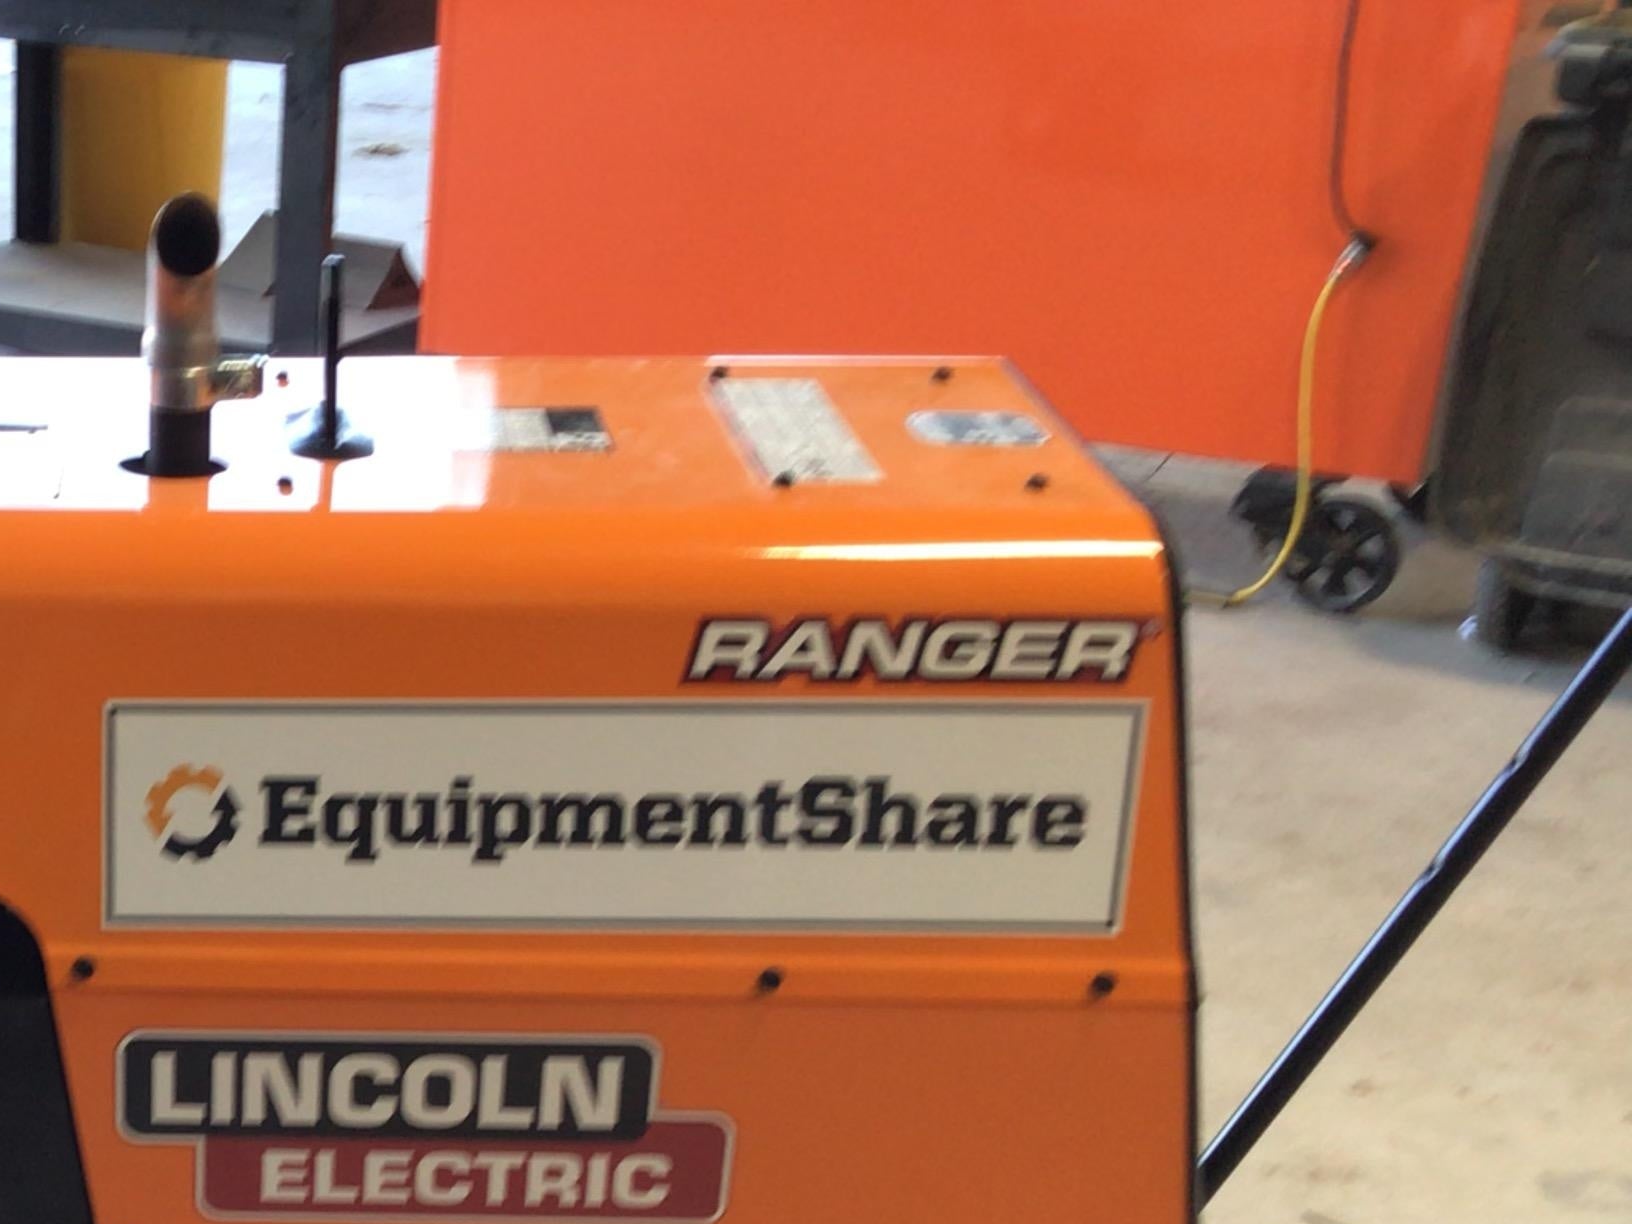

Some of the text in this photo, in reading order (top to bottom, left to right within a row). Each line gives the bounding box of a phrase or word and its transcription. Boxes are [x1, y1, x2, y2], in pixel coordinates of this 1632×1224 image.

[684, 617, 1138, 683] RANGER
[258, 774, 1086, 865] EquipmentShare
[150, 1050, 626, 1132] LINCOLN
[259, 1148, 673, 1208] ELECTRIC
